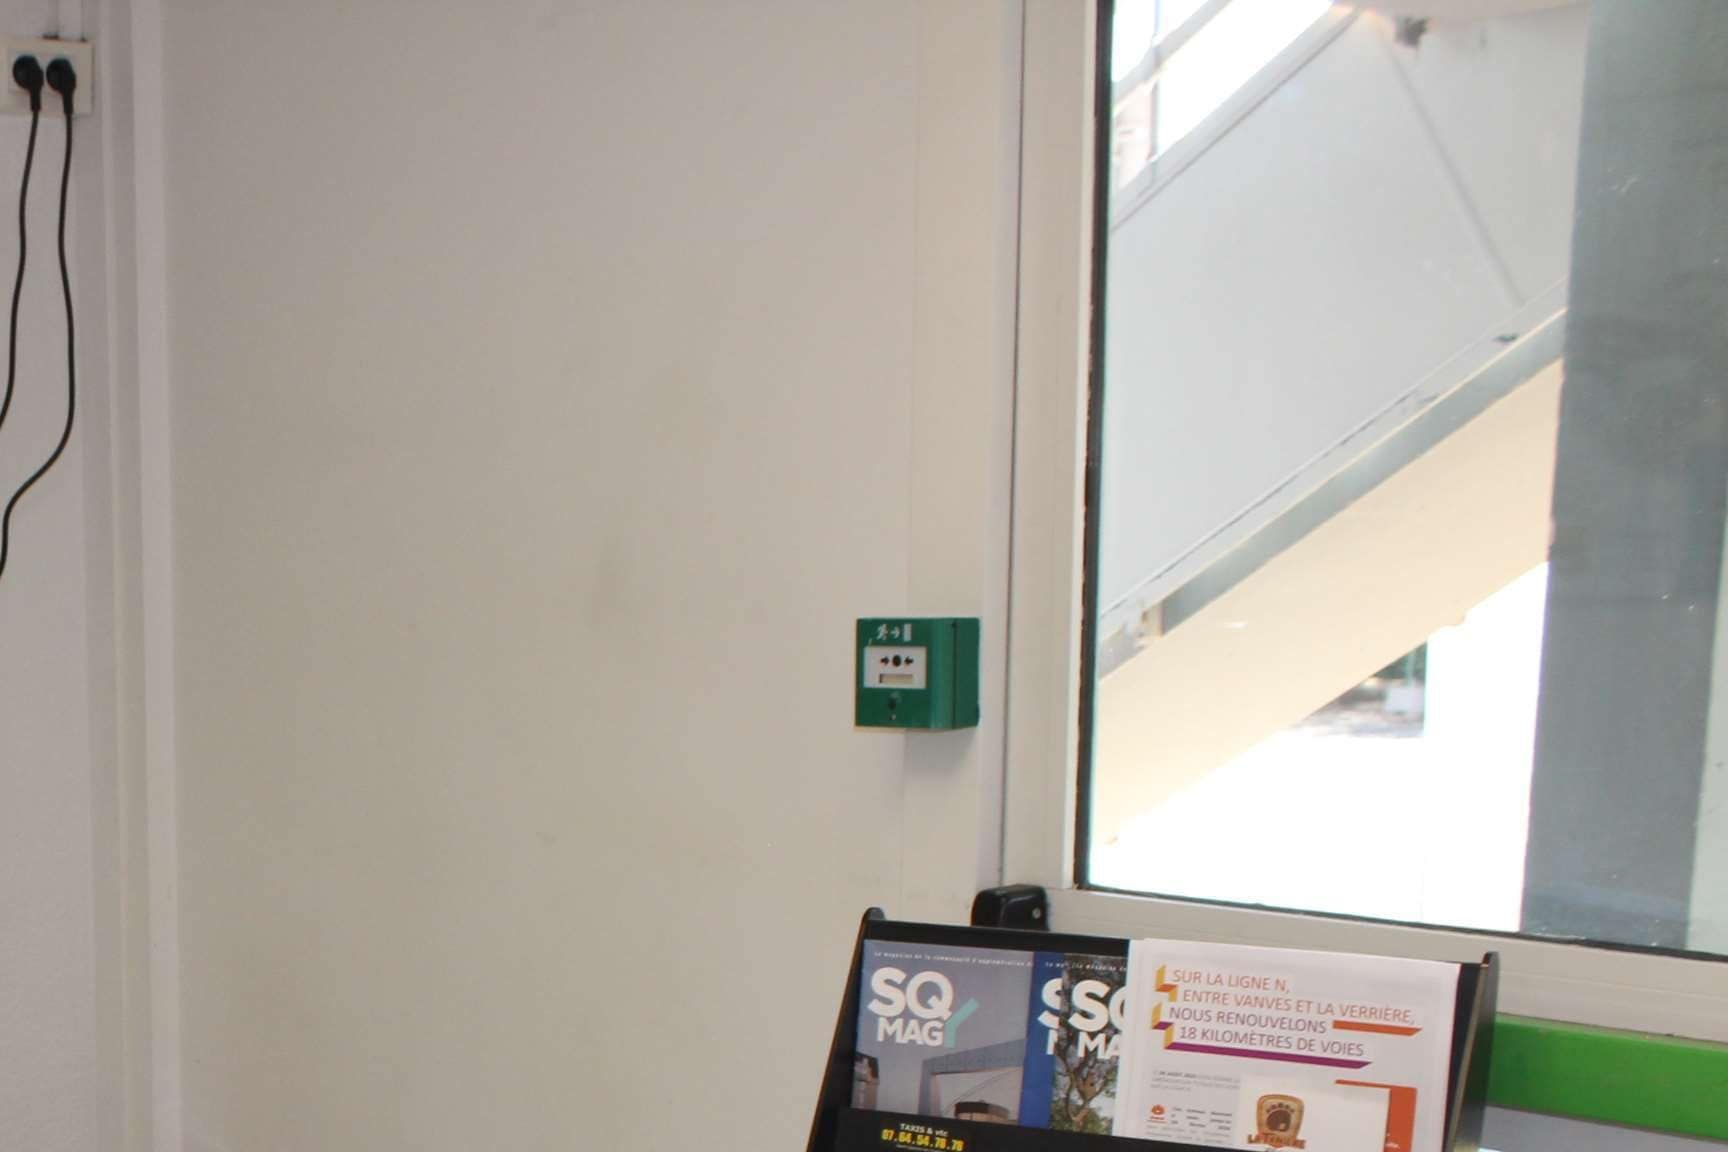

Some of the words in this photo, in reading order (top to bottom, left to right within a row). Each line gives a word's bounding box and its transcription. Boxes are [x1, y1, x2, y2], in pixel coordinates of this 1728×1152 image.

[1172, 969, 1201, 984] SUR
[1207, 972, 1223, 985] LA
[1228, 974, 1271, 990] LIGNE
[1275, 978, 1290, 994] N,
[1169, 1007, 1212, 1023] NOUS
[1216, 1011, 1327, 1034] RENOUVELONS
[1184, 989, 1229, 1005] ENTRE
[1233, 993, 1291, 1012] VANVES
[1296, 1000, 1312, 1013] ET
[1317, 1002, 1335, 1016] LA
[1338, 1002, 1415, 1025] VERRIÈRE,
[876, 1016, 944, 1047] MAG
[1180, 1026, 1196, 1039] 18
[1201, 1026, 1292, 1049] KILOMÈTRES
[1297, 1036, 1315, 1051] DE
[1320, 1039, 1364, 1056] VOIES
